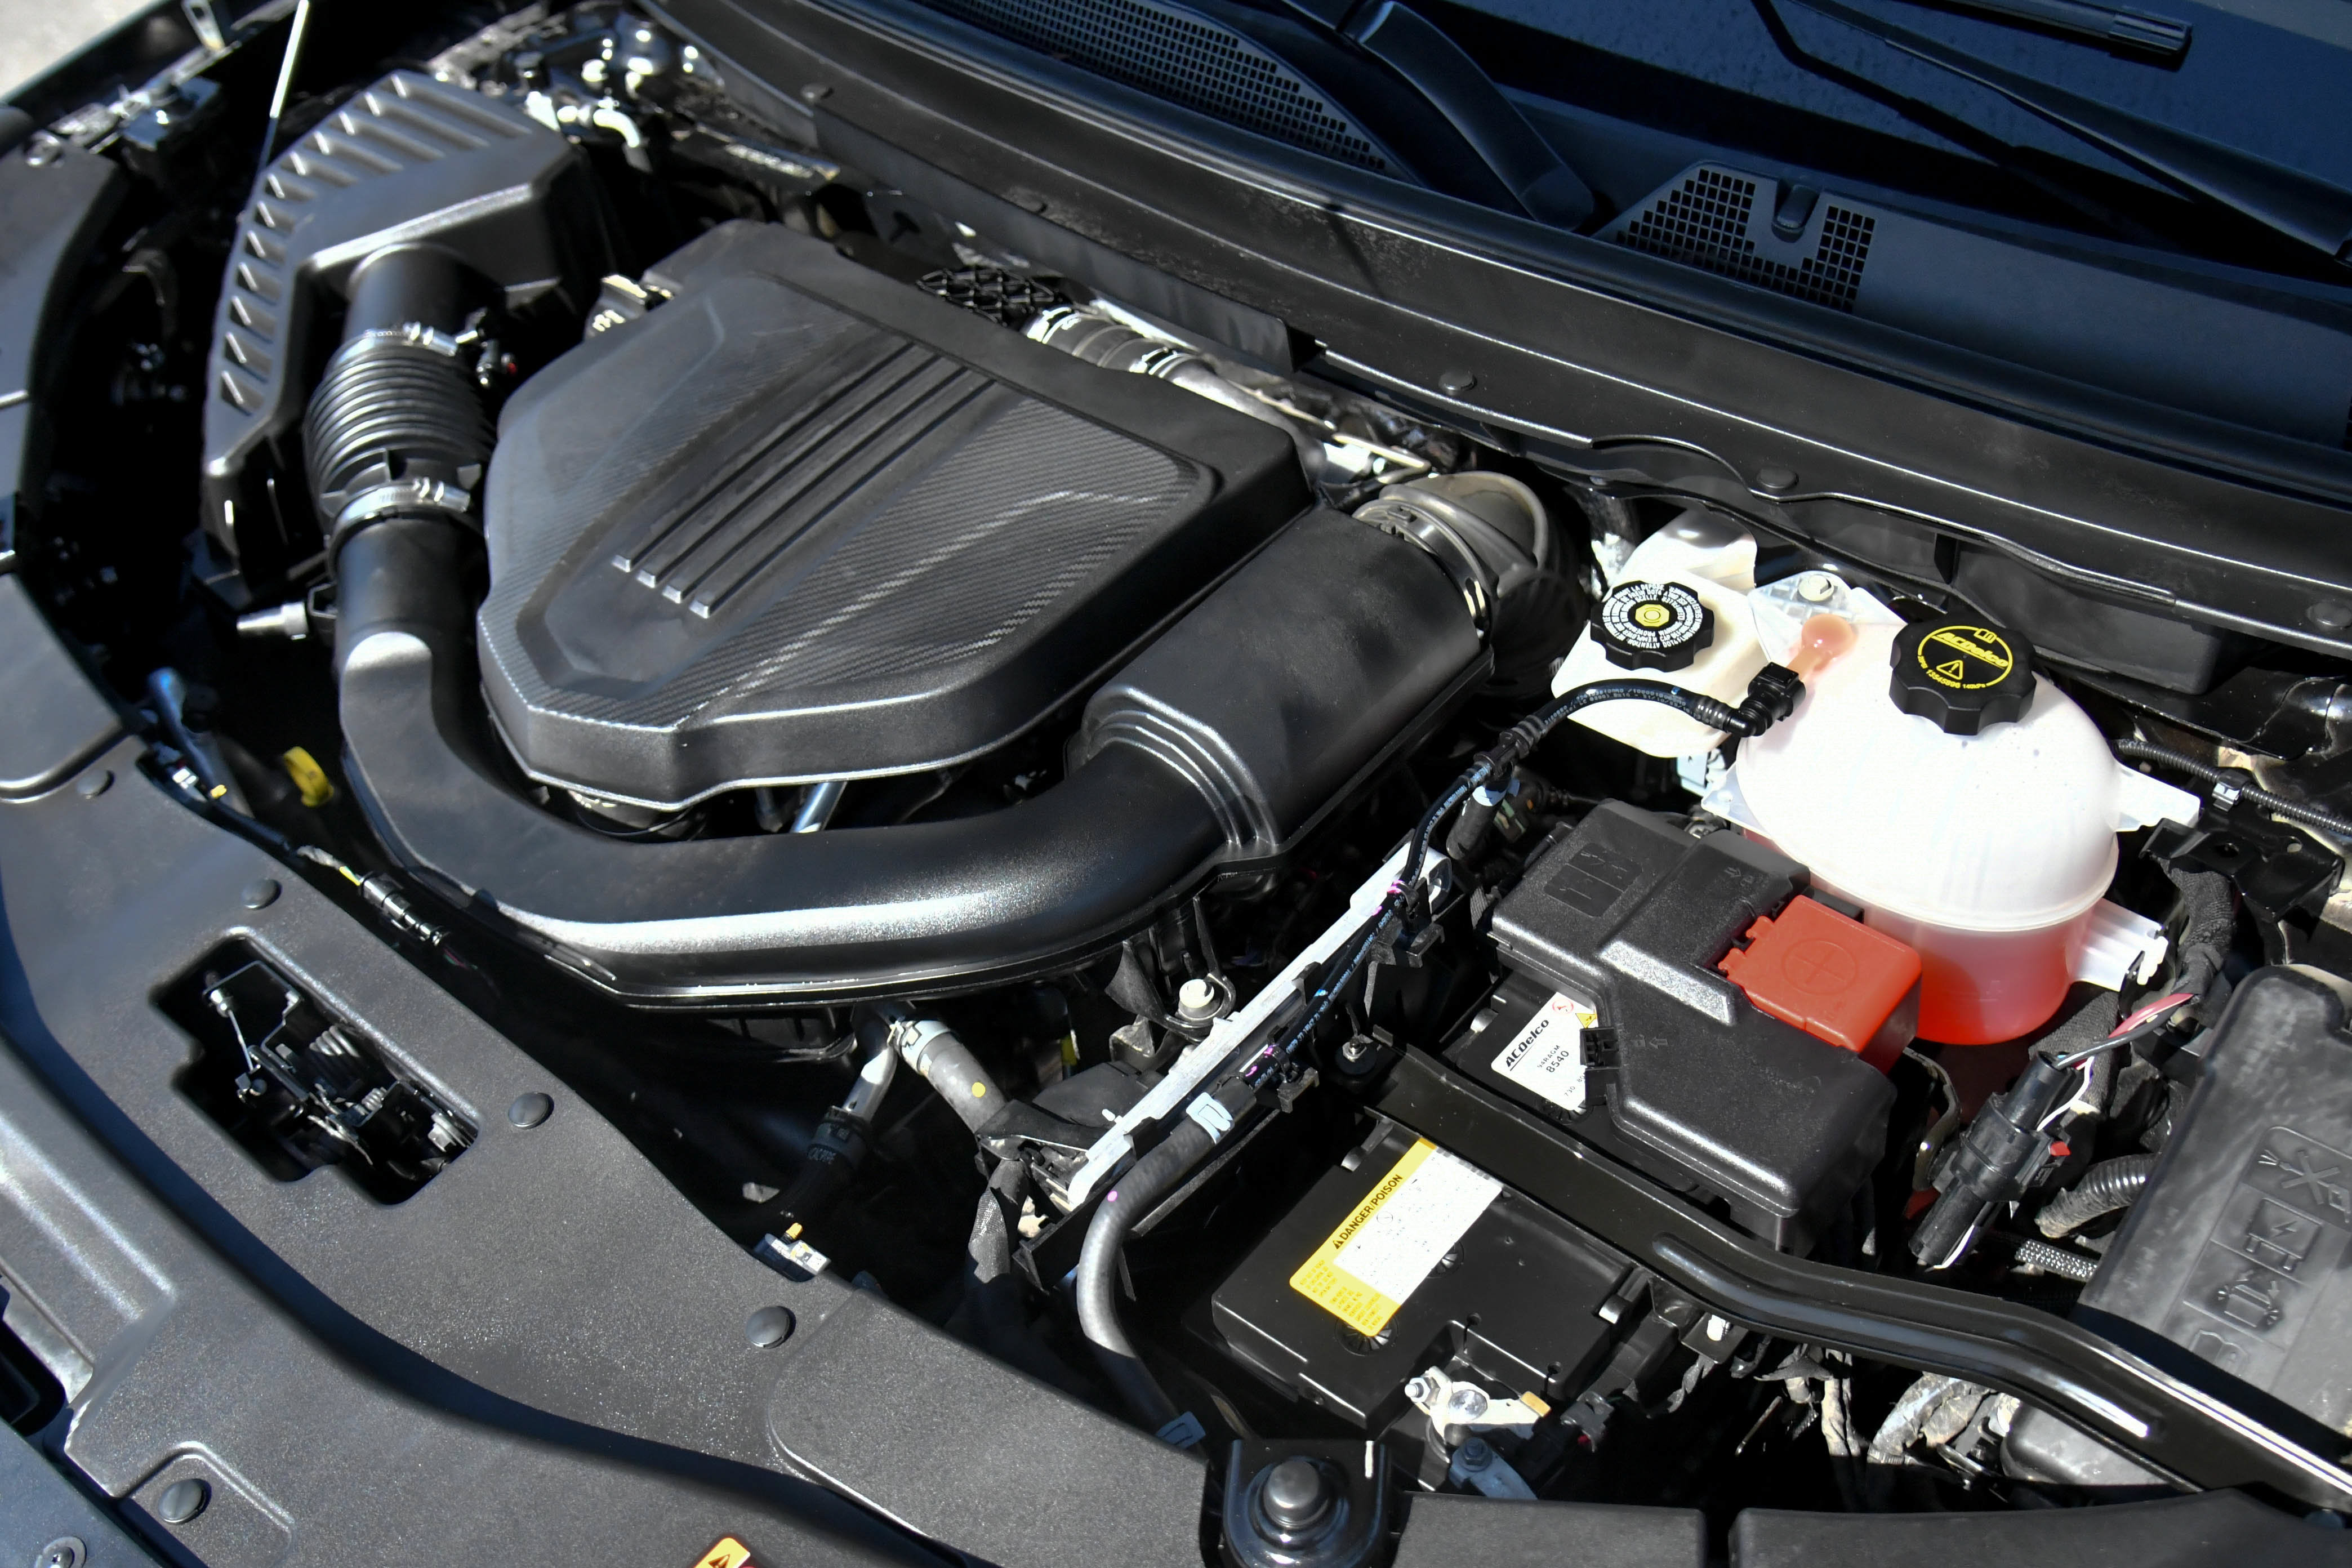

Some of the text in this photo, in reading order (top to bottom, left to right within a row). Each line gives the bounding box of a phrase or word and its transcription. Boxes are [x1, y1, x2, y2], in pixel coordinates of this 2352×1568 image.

[1936, 632, 2009, 667] ACDelco
[1505, 1019, 1549, 1067] ACDelco
[1546, 1050, 1570, 1073] 8540
[1341, 1174, 1402, 1242] DANGER/POISON
